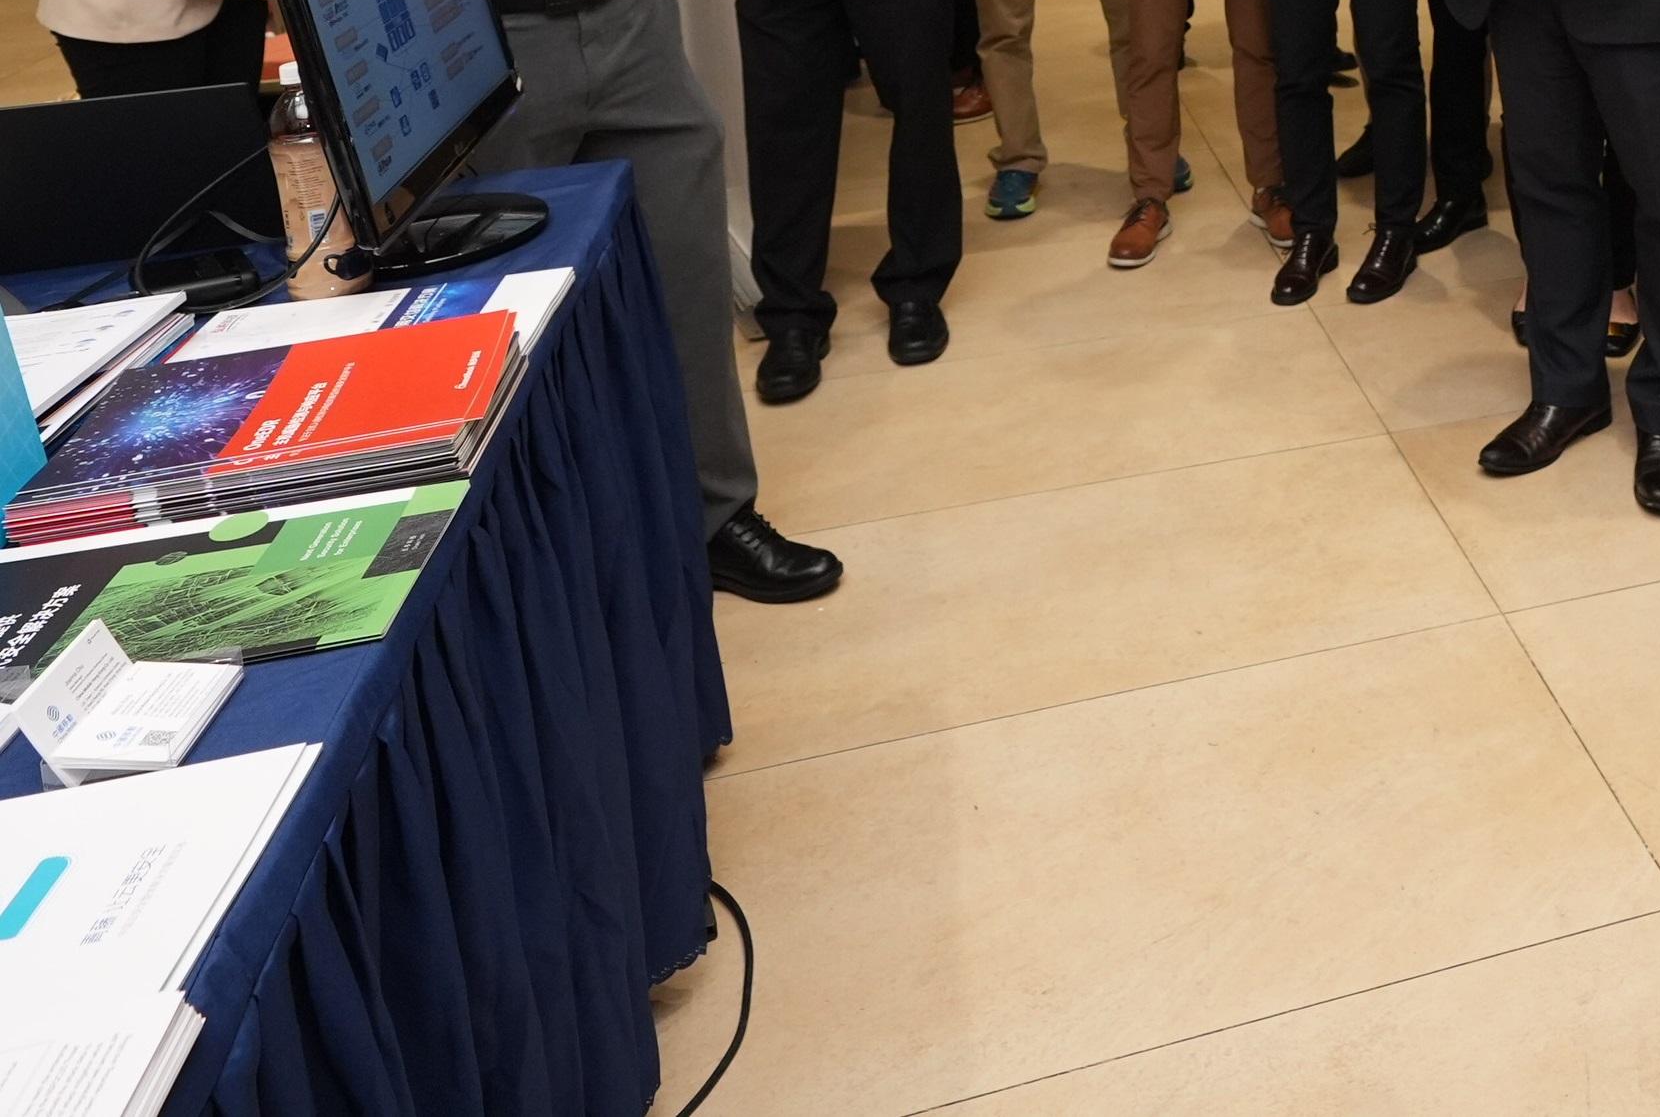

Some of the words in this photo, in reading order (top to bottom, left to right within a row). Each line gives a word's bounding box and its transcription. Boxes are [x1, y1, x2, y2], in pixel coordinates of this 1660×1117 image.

[243, 419, 281, 451] OneEDR
[308, 522, 333, 550] Generation
[316, 537, 337, 558] Security
